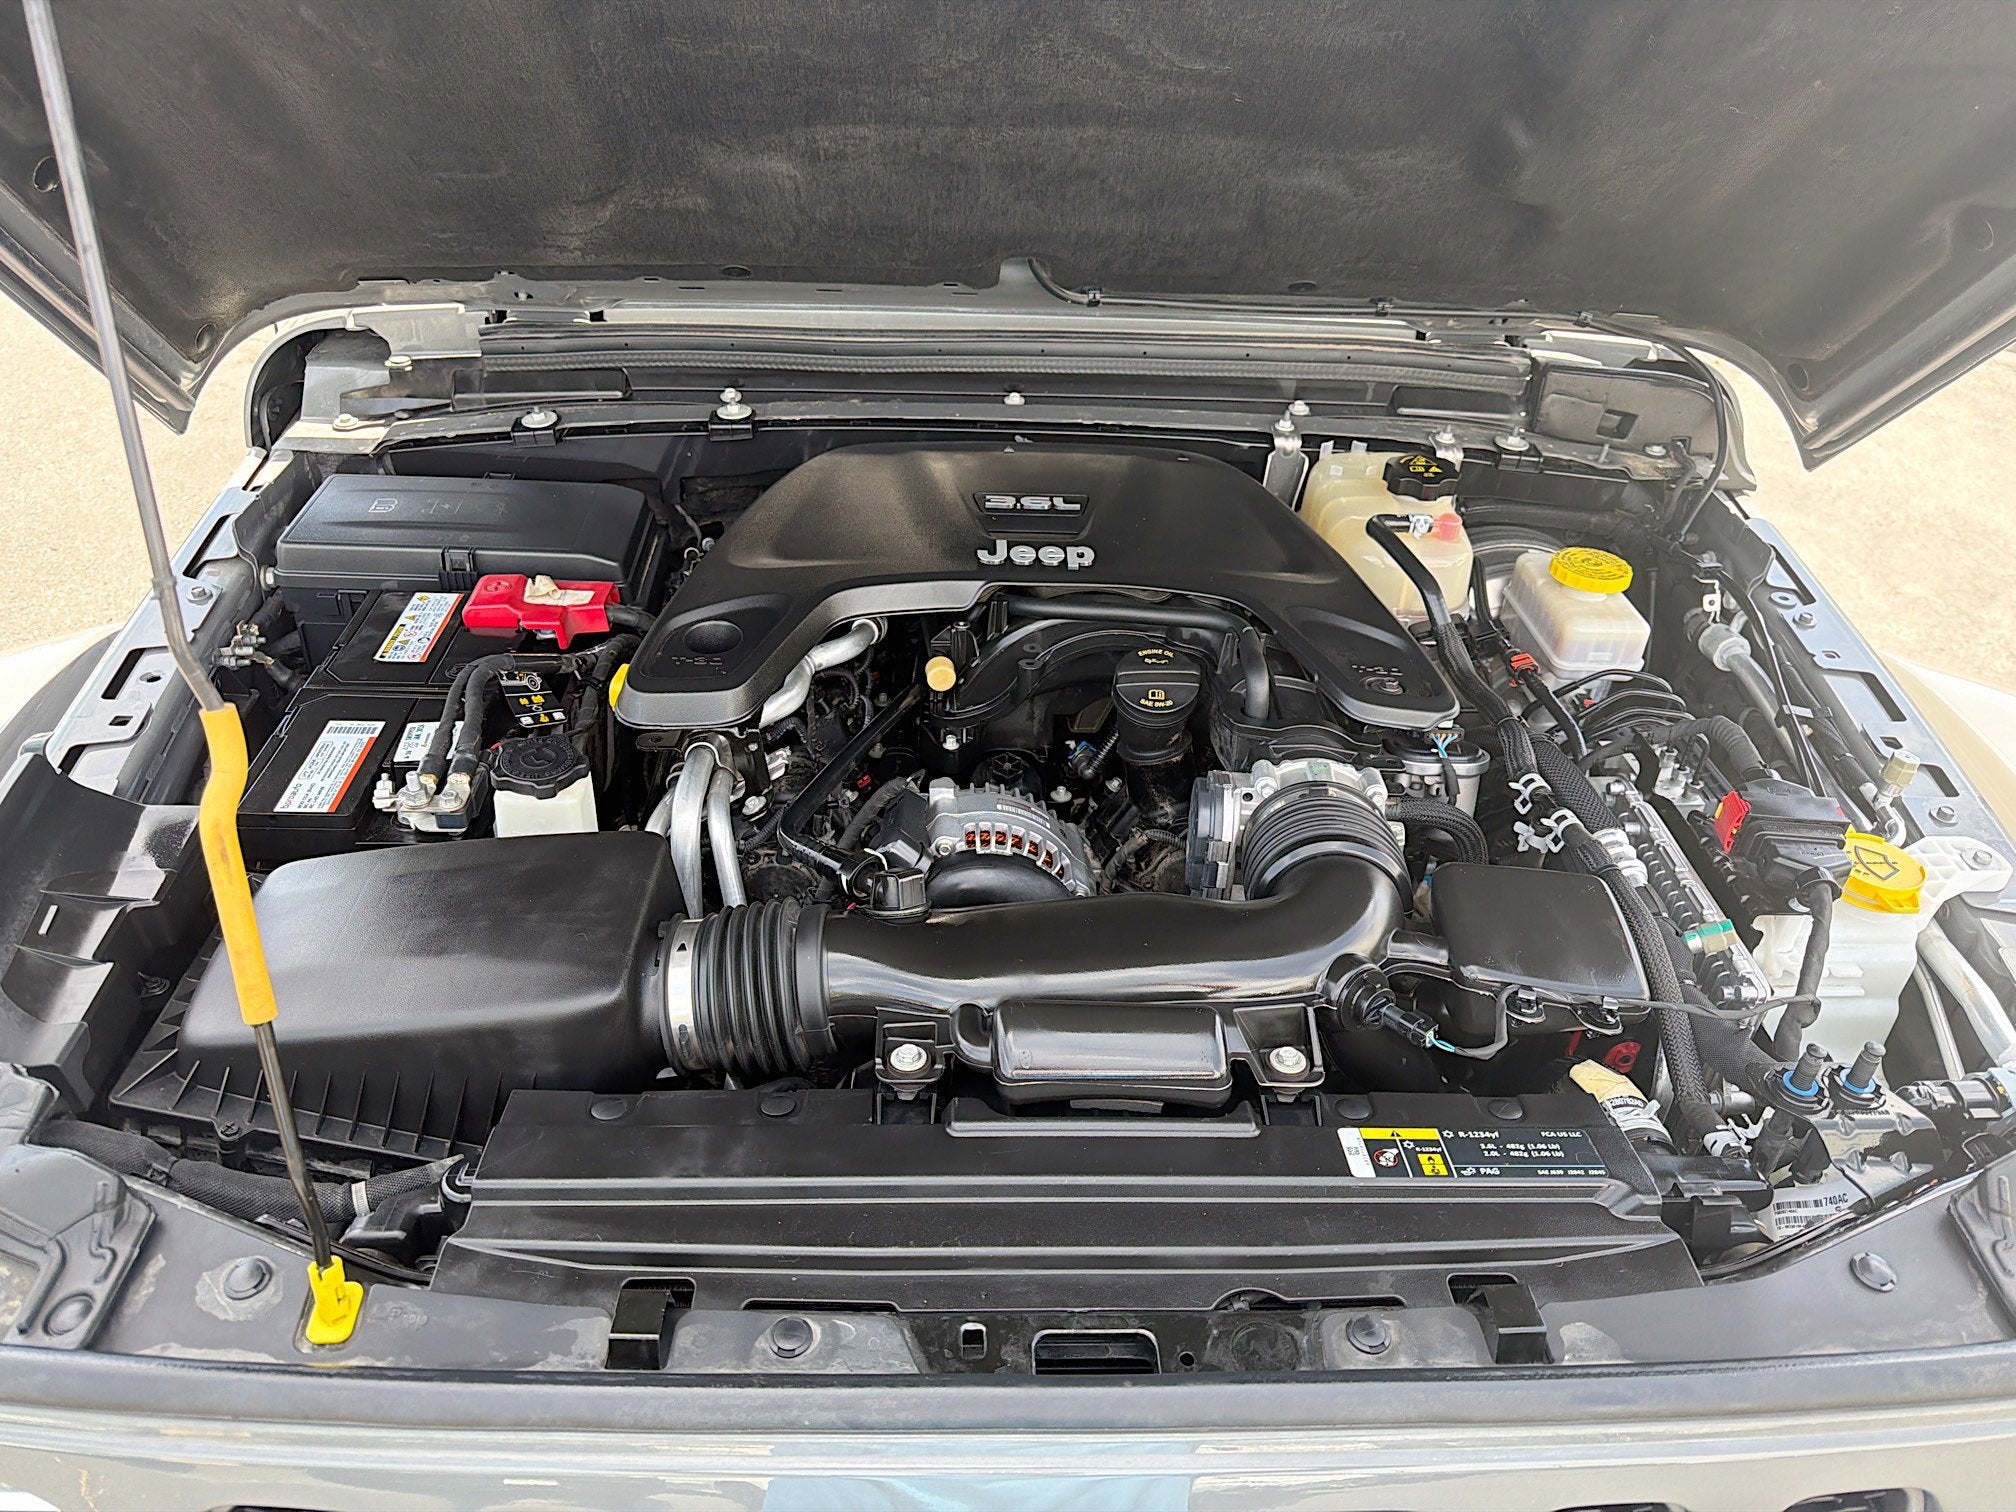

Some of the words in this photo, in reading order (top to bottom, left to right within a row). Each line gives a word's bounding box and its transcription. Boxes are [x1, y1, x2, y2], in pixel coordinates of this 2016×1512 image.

[985, 495, 1081, 510] 3.6L
[977, 539, 1095, 571] Jeep
[1137, 649, 1163, 657] ENGINE
[1163, 650, 1174, 658] OIL
[1139, 698, 1153, 707] SAE
[1457, 1131, 1499, 1139] R-1234yf
[1479, 1167, 1500, 1175] PAG
[1823, 1193, 1849, 1207] 740AC
[388, 1306, 428, 1332] Prop
